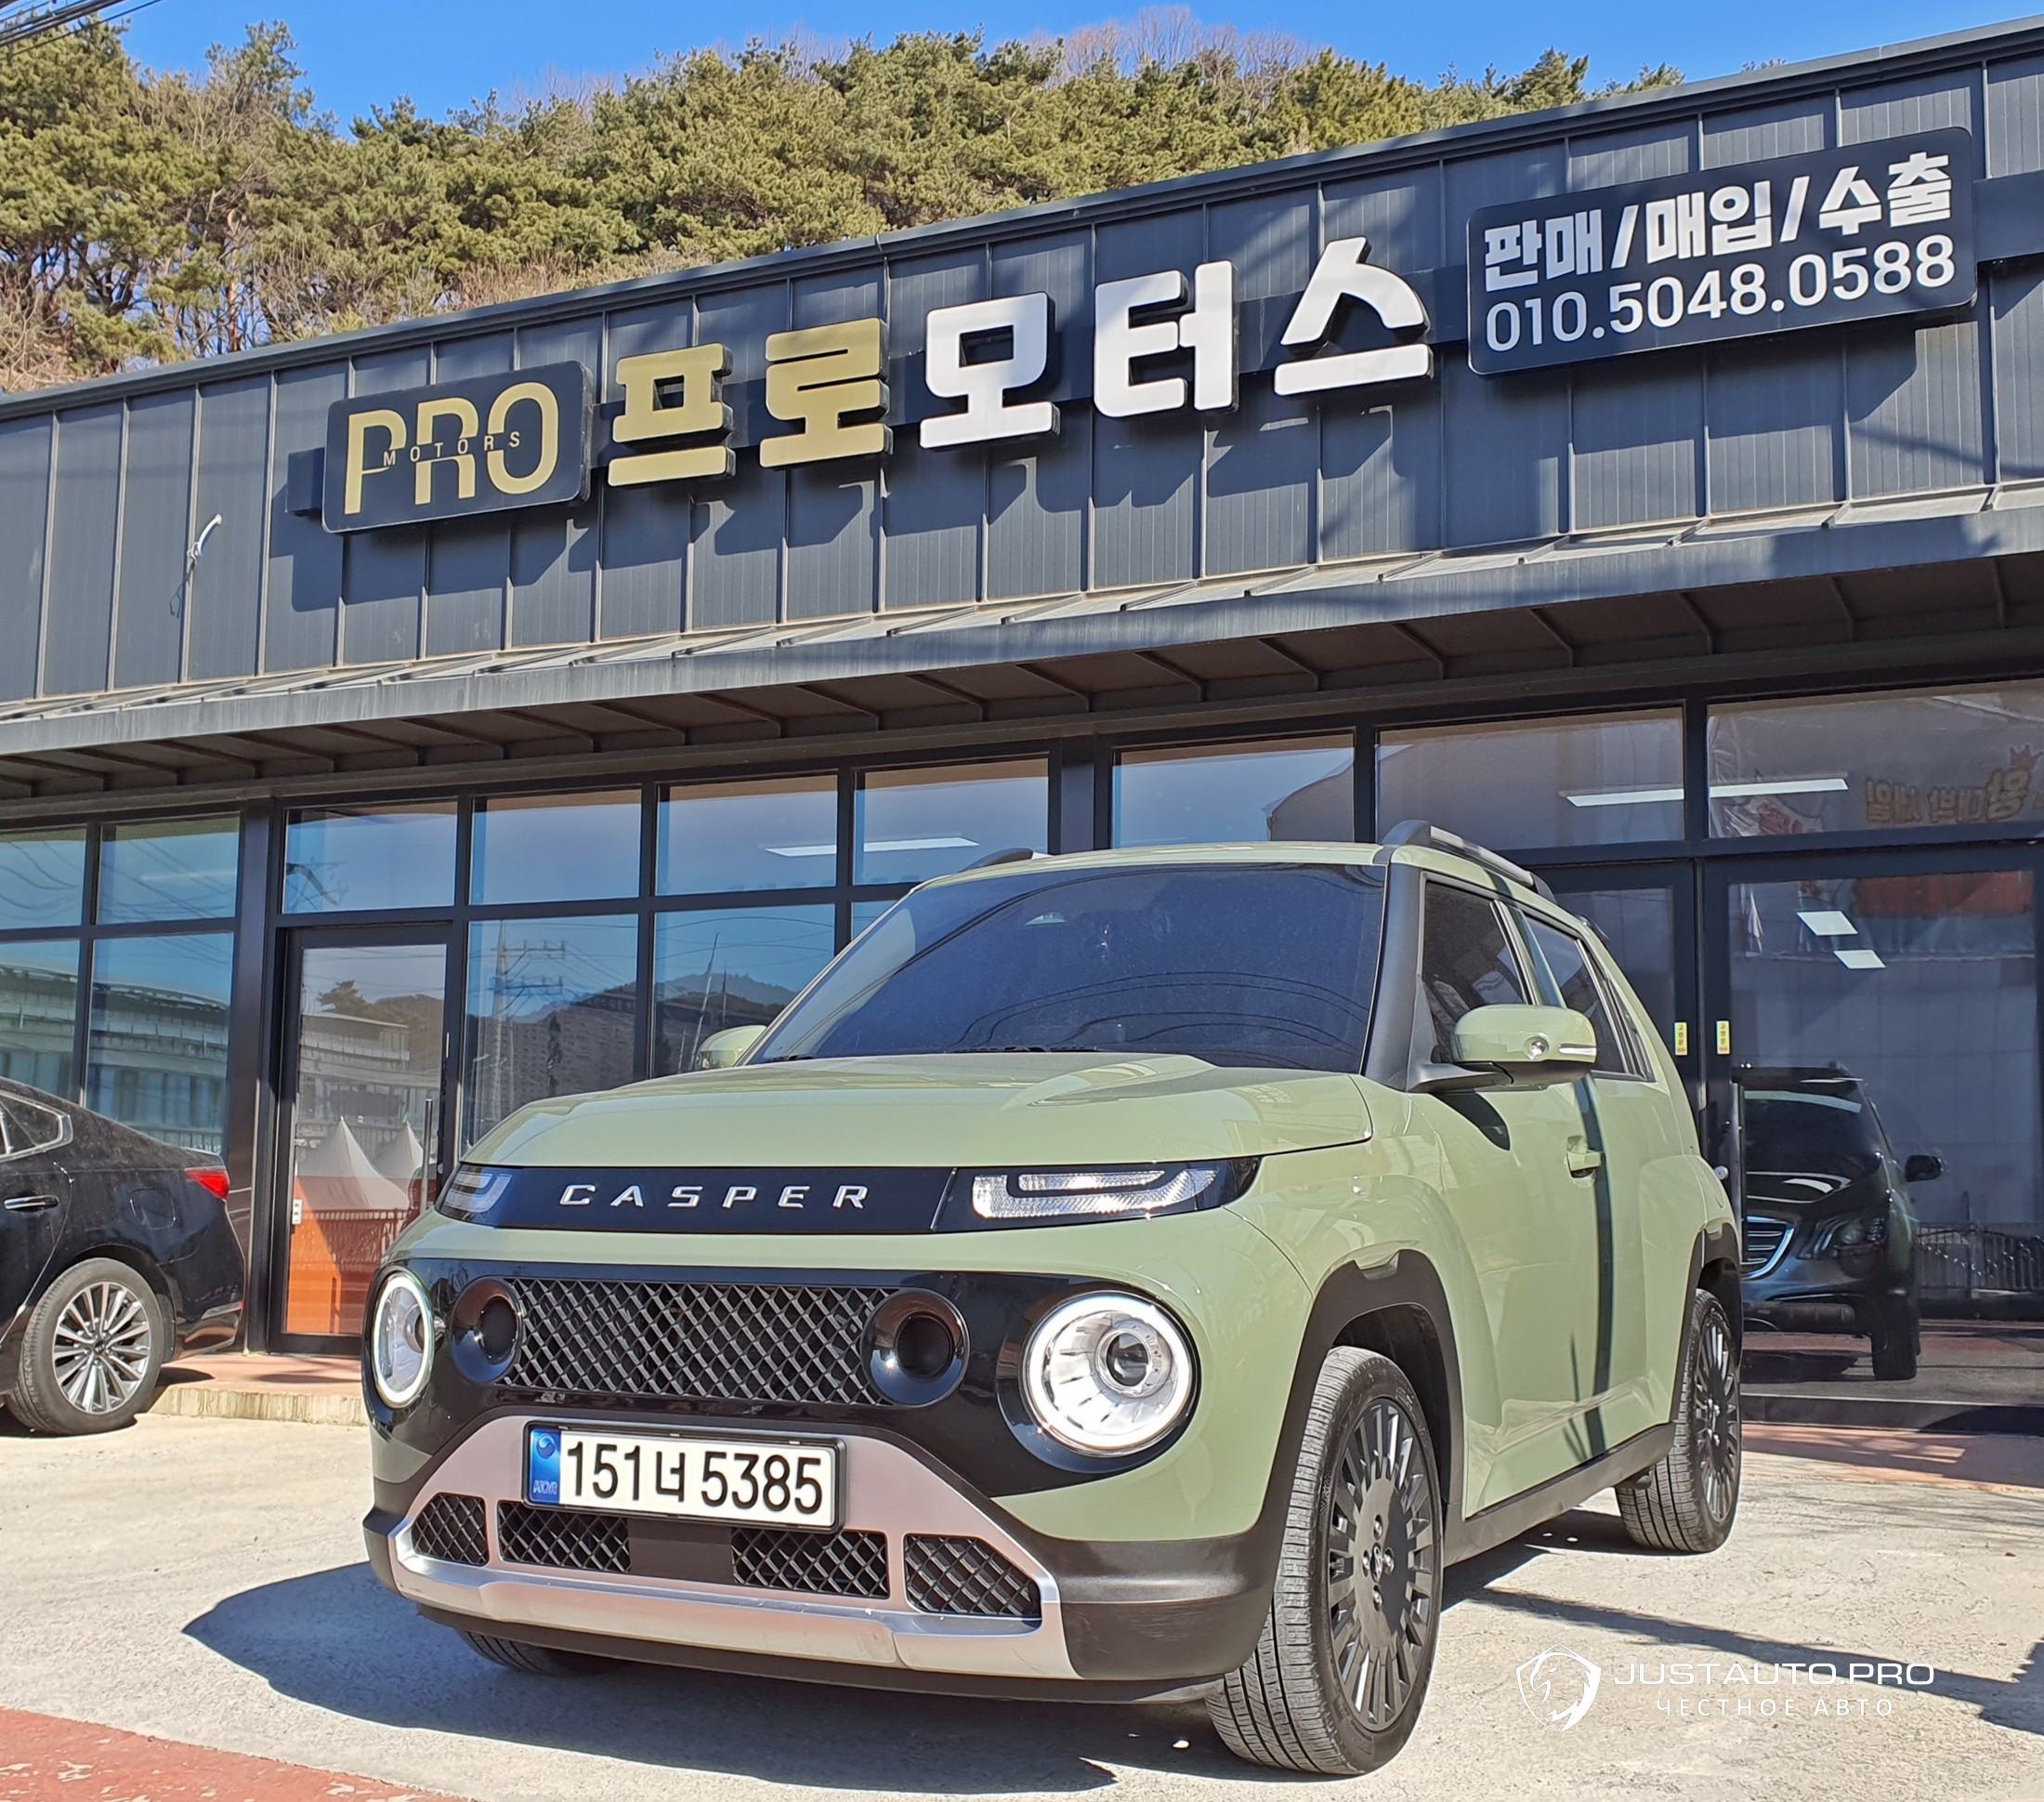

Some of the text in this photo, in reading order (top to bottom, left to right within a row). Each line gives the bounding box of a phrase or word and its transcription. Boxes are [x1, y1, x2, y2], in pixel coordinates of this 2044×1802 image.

[1484, 151, 1952, 292] 판매/매입/수출
[1486, 234, 1956, 352] 010.5048.0588
[345, 382, 559, 515] PRO
[383, 431, 520, 467] MOTORS
[559, 1184, 869, 1208] CASPER
